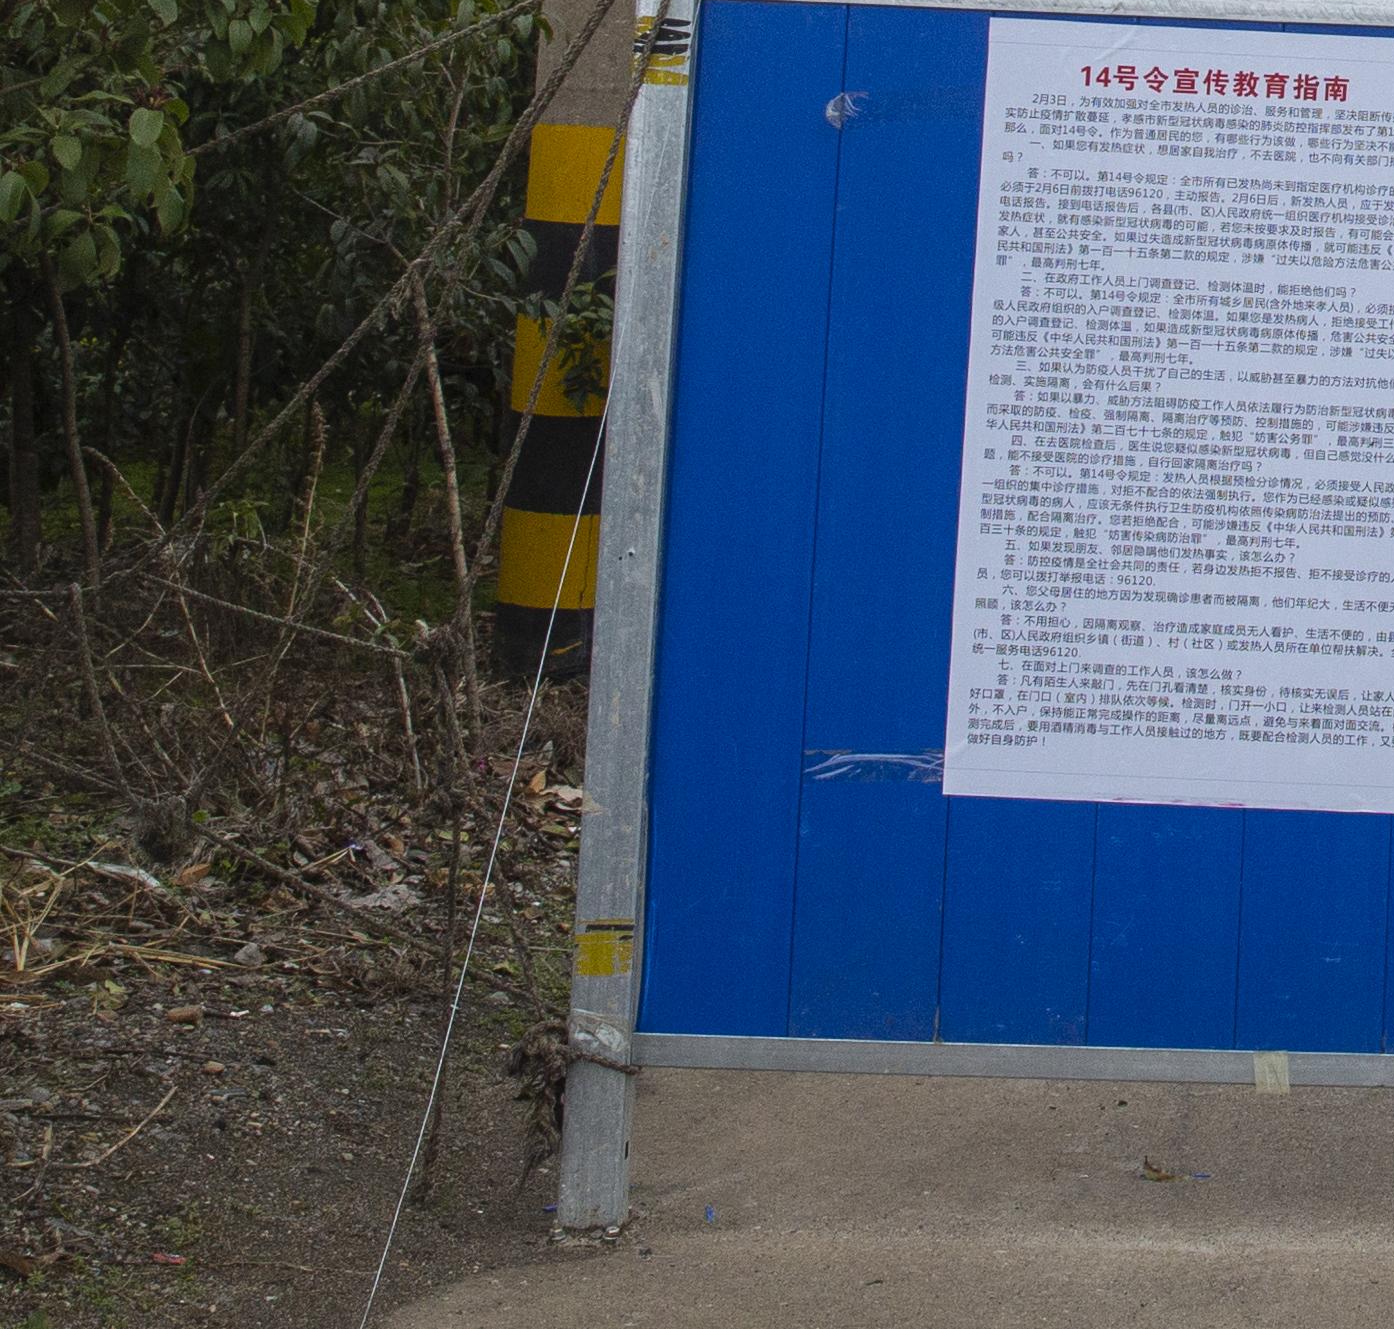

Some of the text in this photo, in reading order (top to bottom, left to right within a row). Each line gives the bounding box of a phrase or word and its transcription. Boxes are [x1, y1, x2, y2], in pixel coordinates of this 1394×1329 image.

[1080, 64, 1351, 103] 14号令宣传教育指南
[1001, 150, 1024, 163] 吗？
[966, 732, 1046, 747] 做好自身防护！
